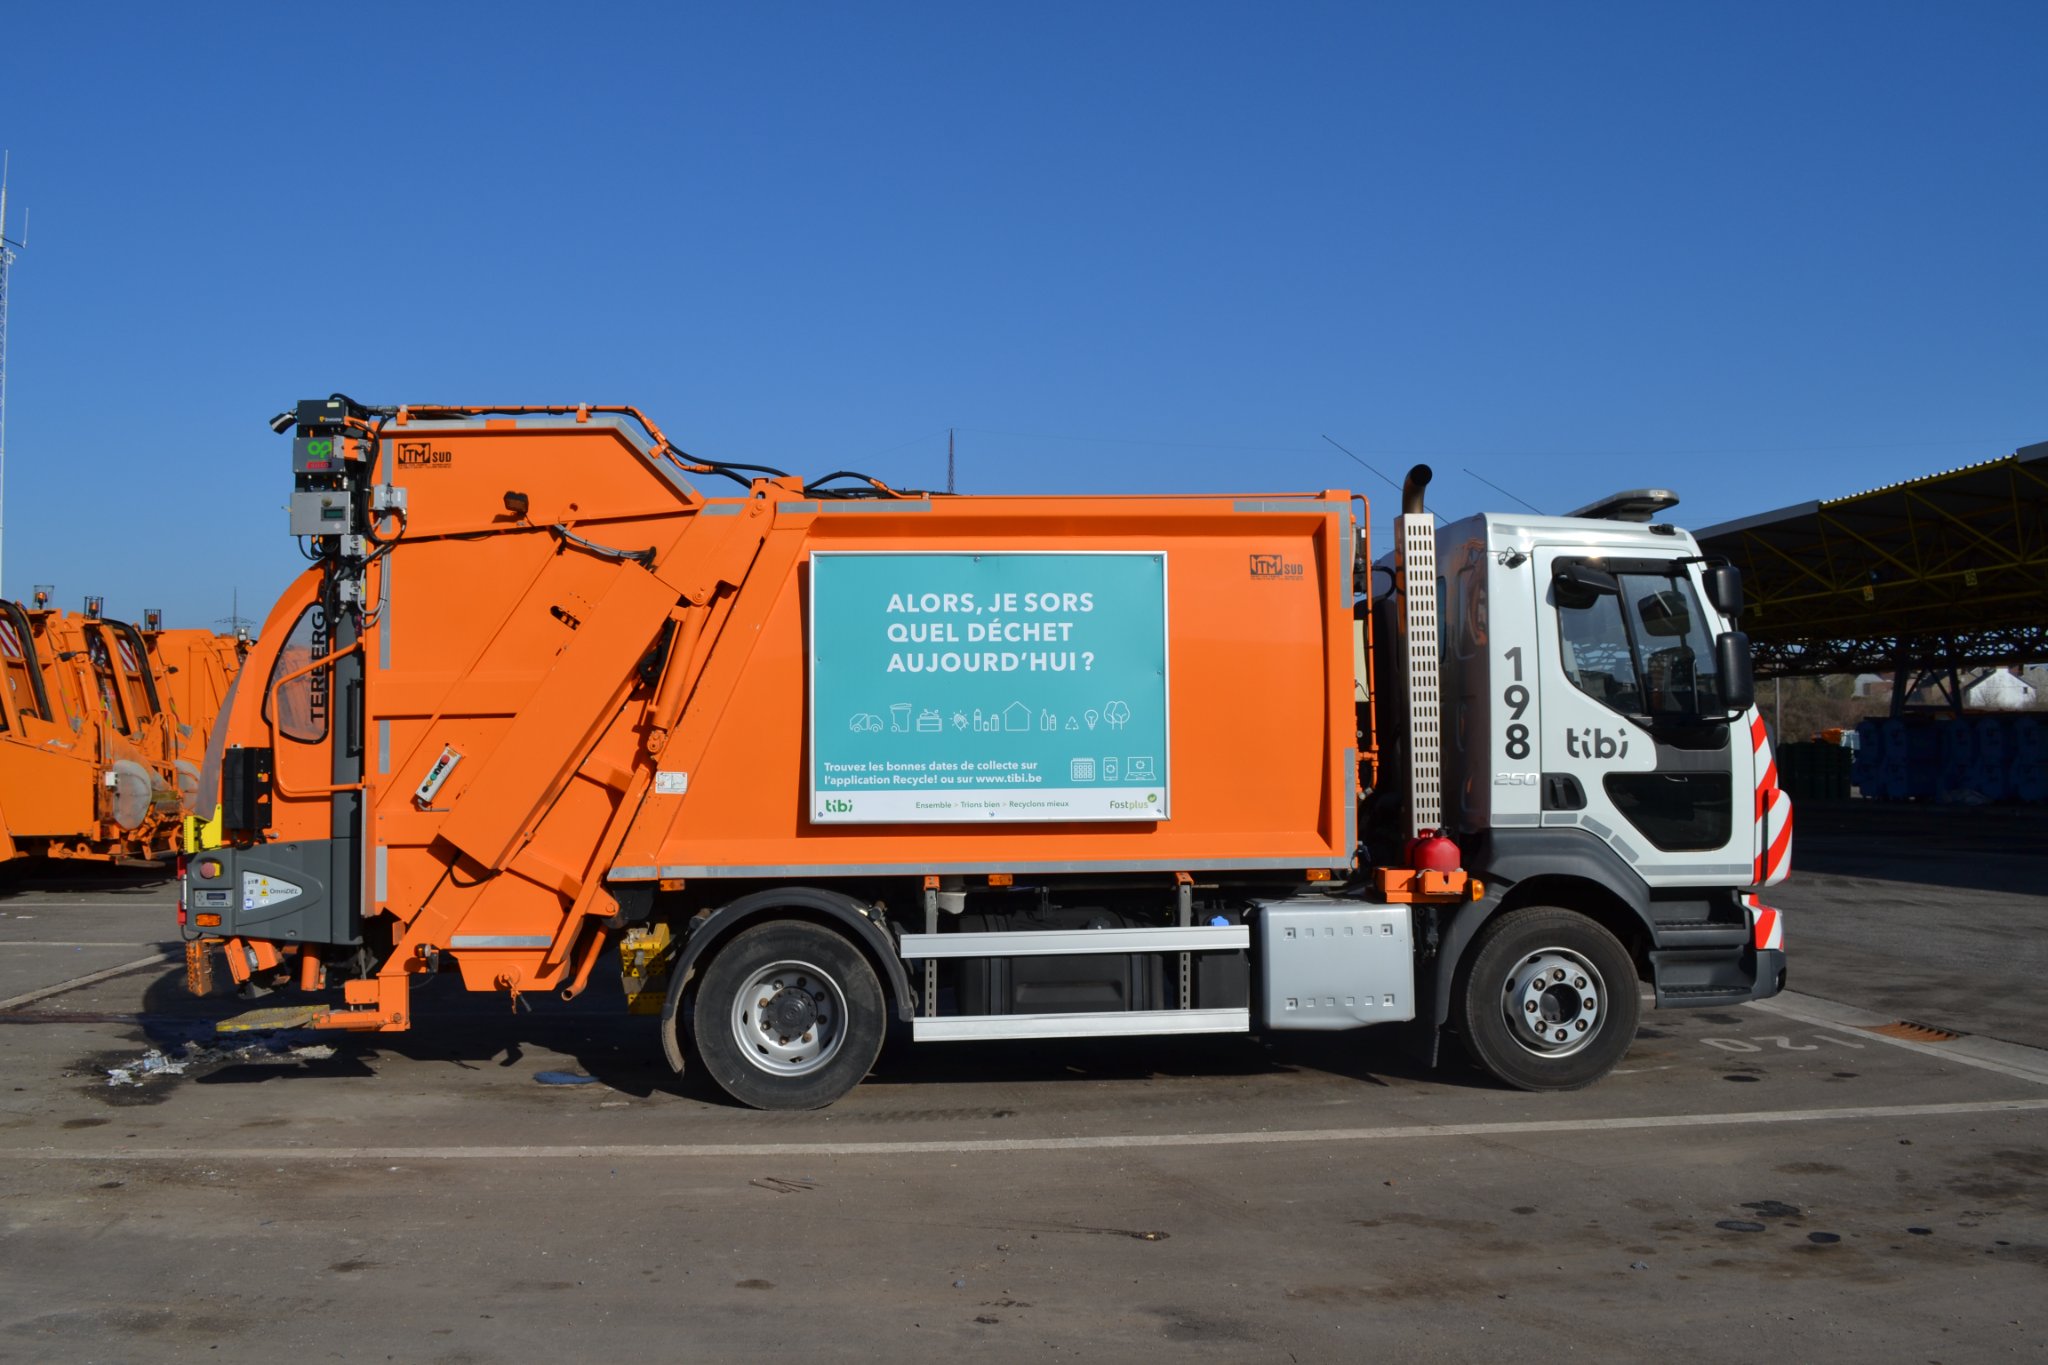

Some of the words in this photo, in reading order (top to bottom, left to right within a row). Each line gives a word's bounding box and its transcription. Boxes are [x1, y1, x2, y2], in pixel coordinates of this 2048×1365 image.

[432, 451, 452, 463] SUD
[1284, 563, 1303, 575] SUD
[886, 592, 983, 615] ALORS,
[988, 593, 1018, 613] JE
[1024, 592, 1094, 612] SORS
[887, 623, 960, 643] QUEL
[967, 617, 1074, 642] DÉCHET
[310, 611, 327, 723] TERBERG
[1566, 727, 1629, 760] tibi
[823, 762, 866, 772] Trouvez
[868, 761, 884, 771] les
[886, 761, 927, 771] bonnes
[929, 761, 958, 771] dates
[960, 760, 975, 770] de
[977, 760, 1018, 770] collecte
[1020, 762, 1038, 770] sur
[824, 775, 891, 786] l'application
[893, 774, 938, 786] Recycle!
[940, 776, 955, 784] ou
[956, 776, 974, 784] sur
[975, 773, 1042, 783] www.tibi.be
[1493, 772, 1540, 786] 250
[825, 799, 853, 813] tibi
[915, 801, 952, 809] Ensemble
[960, 800, 983, 809] Trions
[984, 800, 1001, 809] bien
[1009, 800, 1045, 810] Recyclons
[1047, 800, 1069, 808] mieux
